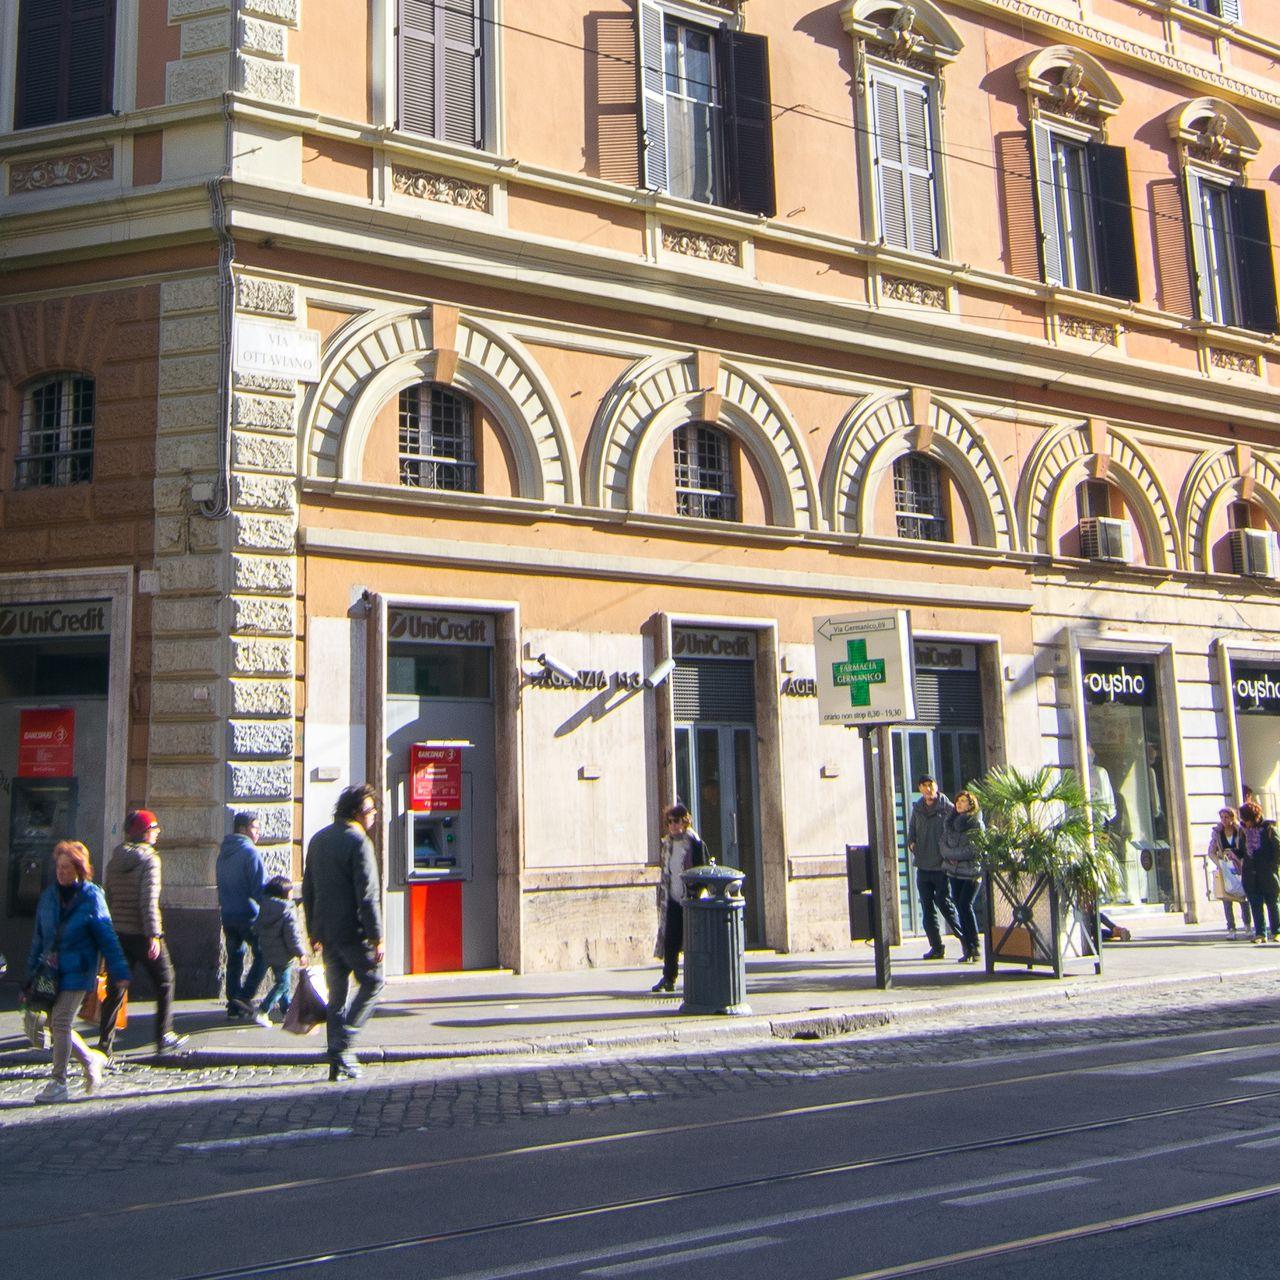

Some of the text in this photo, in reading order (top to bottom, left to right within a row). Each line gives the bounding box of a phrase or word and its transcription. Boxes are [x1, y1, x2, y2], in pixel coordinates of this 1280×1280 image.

[265, 333, 288, 347] VIA
[242, 350, 313, 370] OTTAVIANO
[20, 607, 105, 633] UniCredit
[409, 615, 487, 642] UniCredit
[833, 625, 843, 633] Via
[686, 632, 750, 656] UniCredit
[839, 662, 877, 672] FARMACIA
[837, 673, 882, 684] GERMANICO
[1089, 666, 1145, 701] oysho
[823, 712, 840, 721] orario
[841, 712, 853, 720] non
[854, 711, 866, 720] stop
